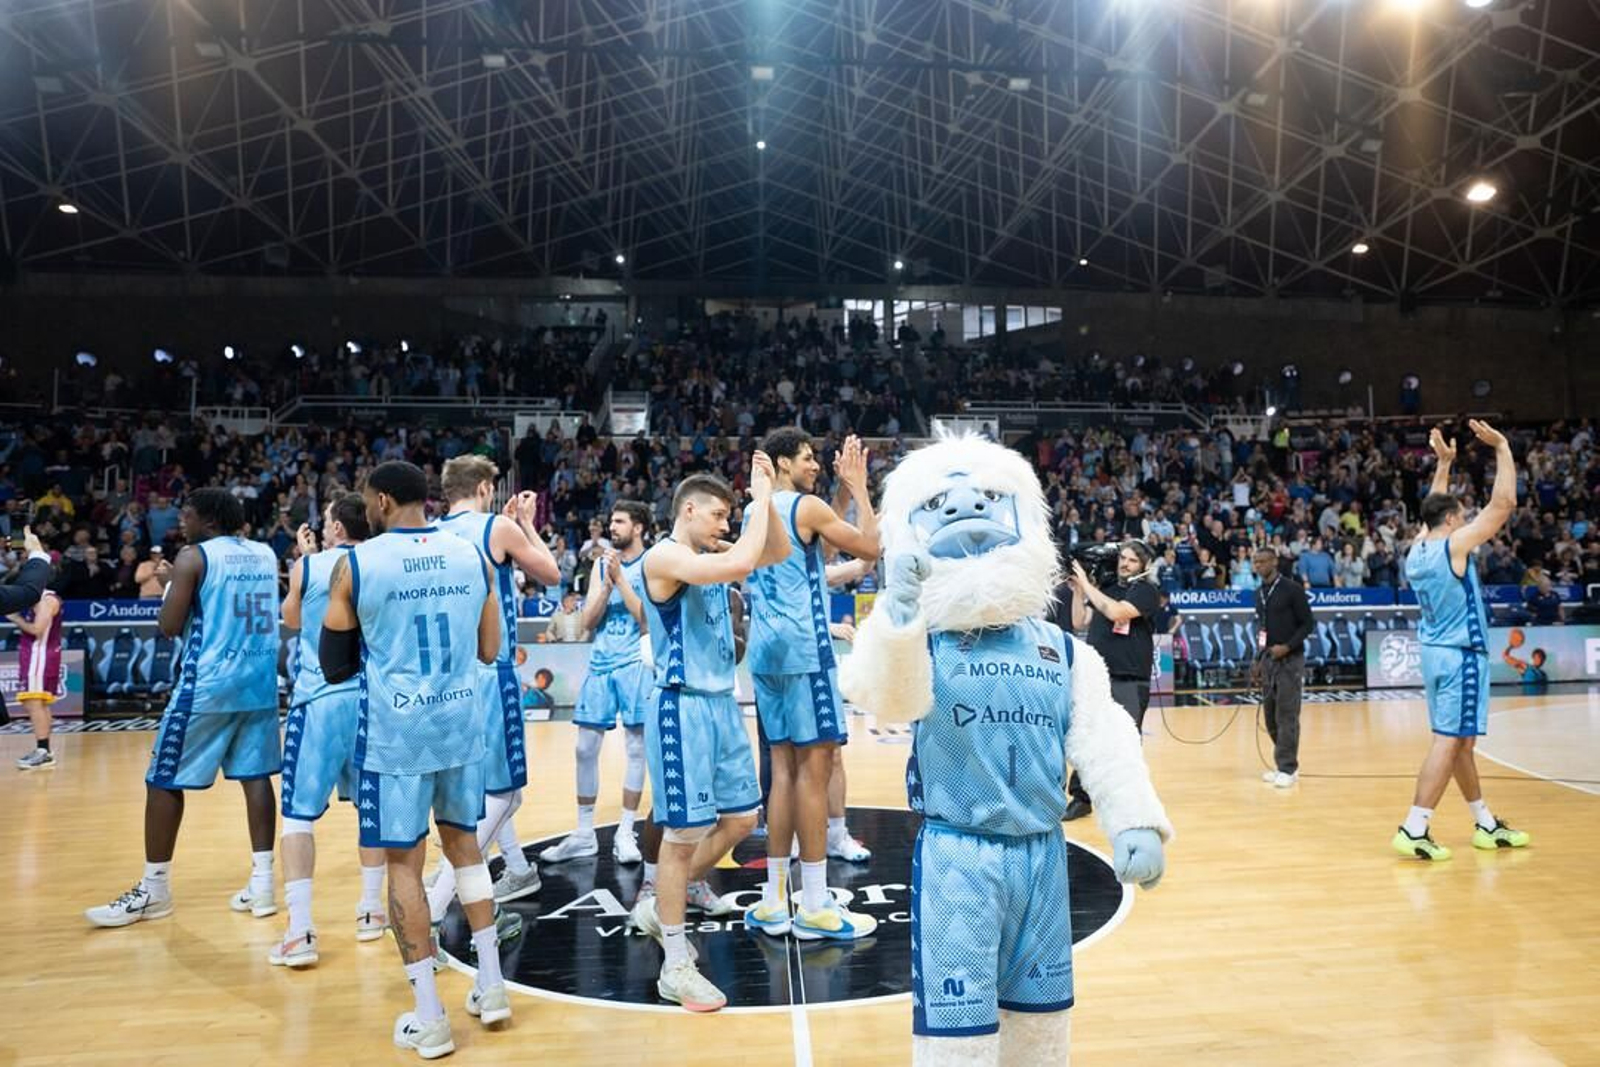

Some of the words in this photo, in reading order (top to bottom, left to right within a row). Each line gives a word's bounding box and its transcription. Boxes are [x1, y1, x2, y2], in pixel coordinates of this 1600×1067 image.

[403, 555, 447, 573] OKOYE
[399, 585, 471, 602] MORABANC
[1169, 591, 1241, 604] MORABANC
[1316, 590, 1362, 603] Andorra
[107, 604, 161, 617] Andorr
[233, 592, 275, 635] 45
[414, 612, 452, 676] 11
[969, 662, 1063, 687] MORABANC
[412, 687, 474, 707] Andorra
